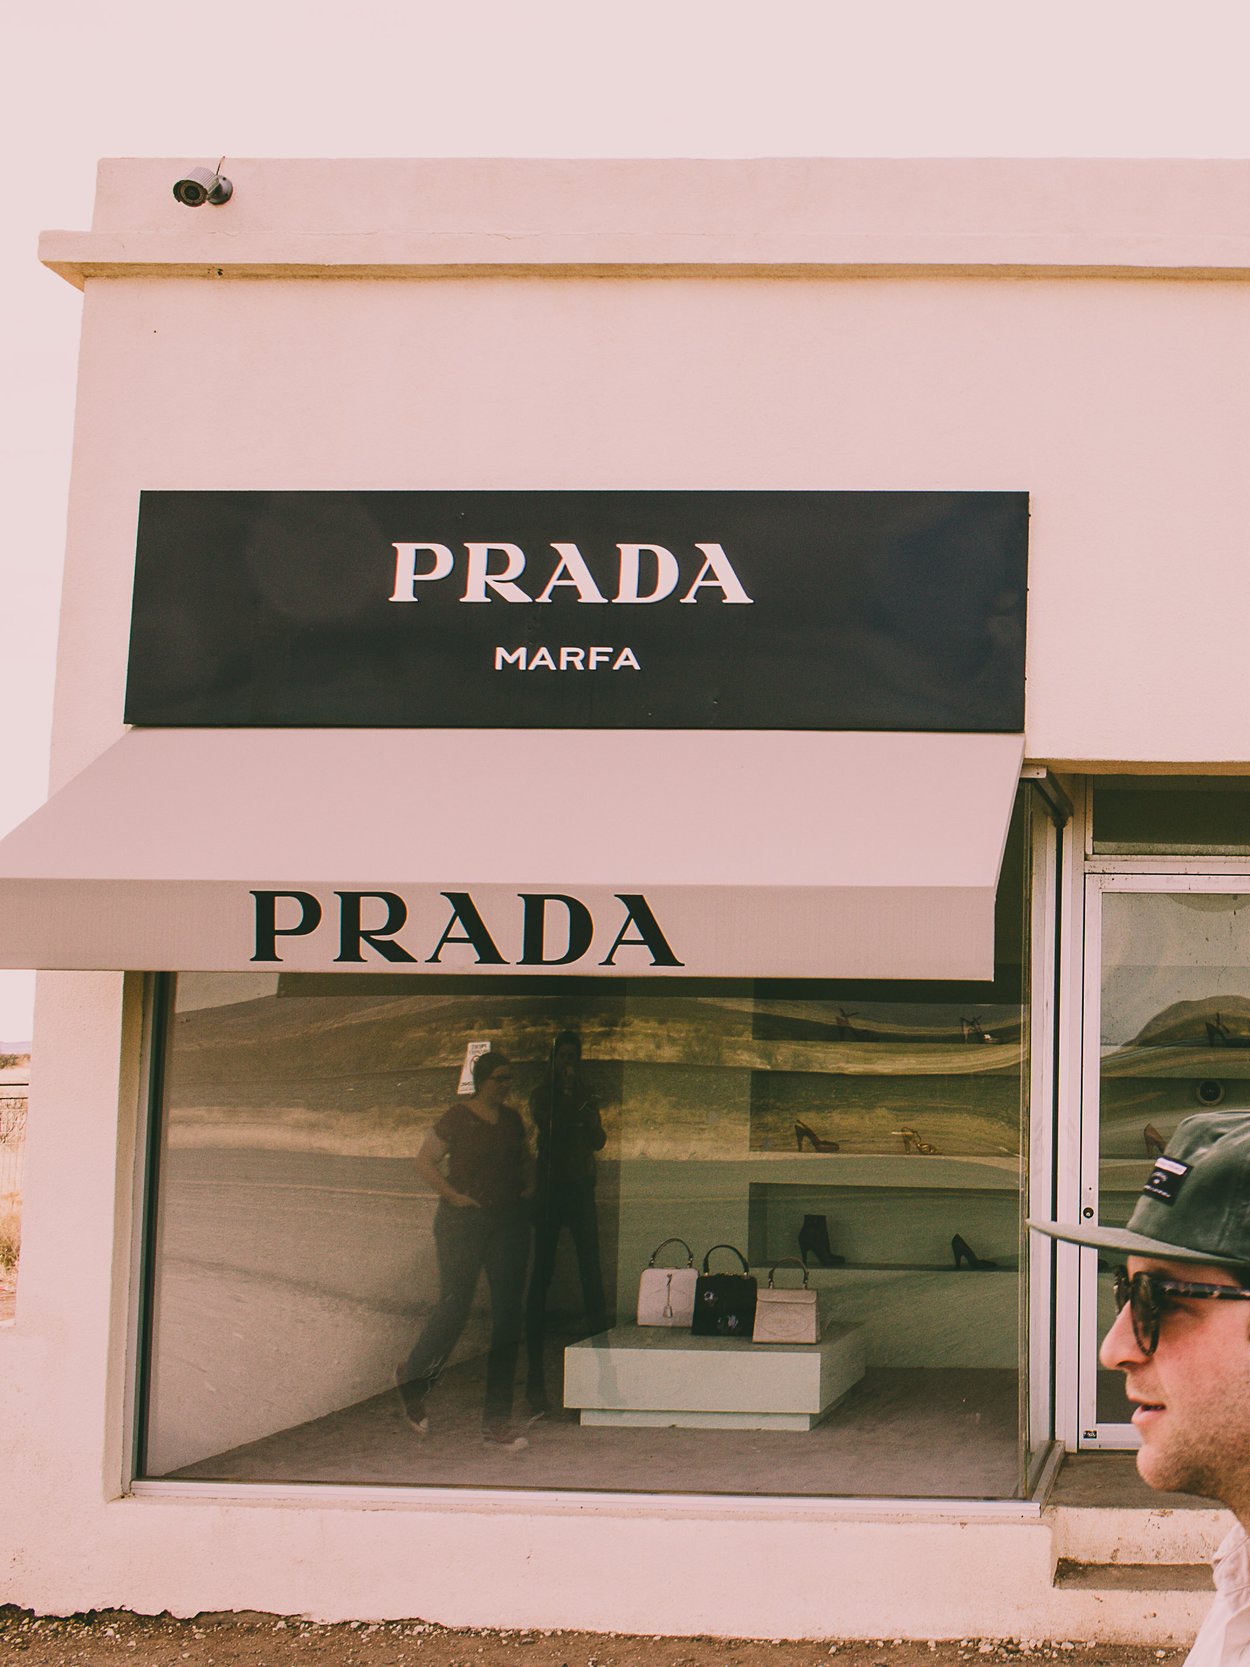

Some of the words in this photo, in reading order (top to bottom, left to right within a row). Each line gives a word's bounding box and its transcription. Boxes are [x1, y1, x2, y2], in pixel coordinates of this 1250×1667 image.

[389, 542, 753, 604] PRADA
[494, 646, 641, 671] MARFA
[249, 890, 686, 967] PRADA
